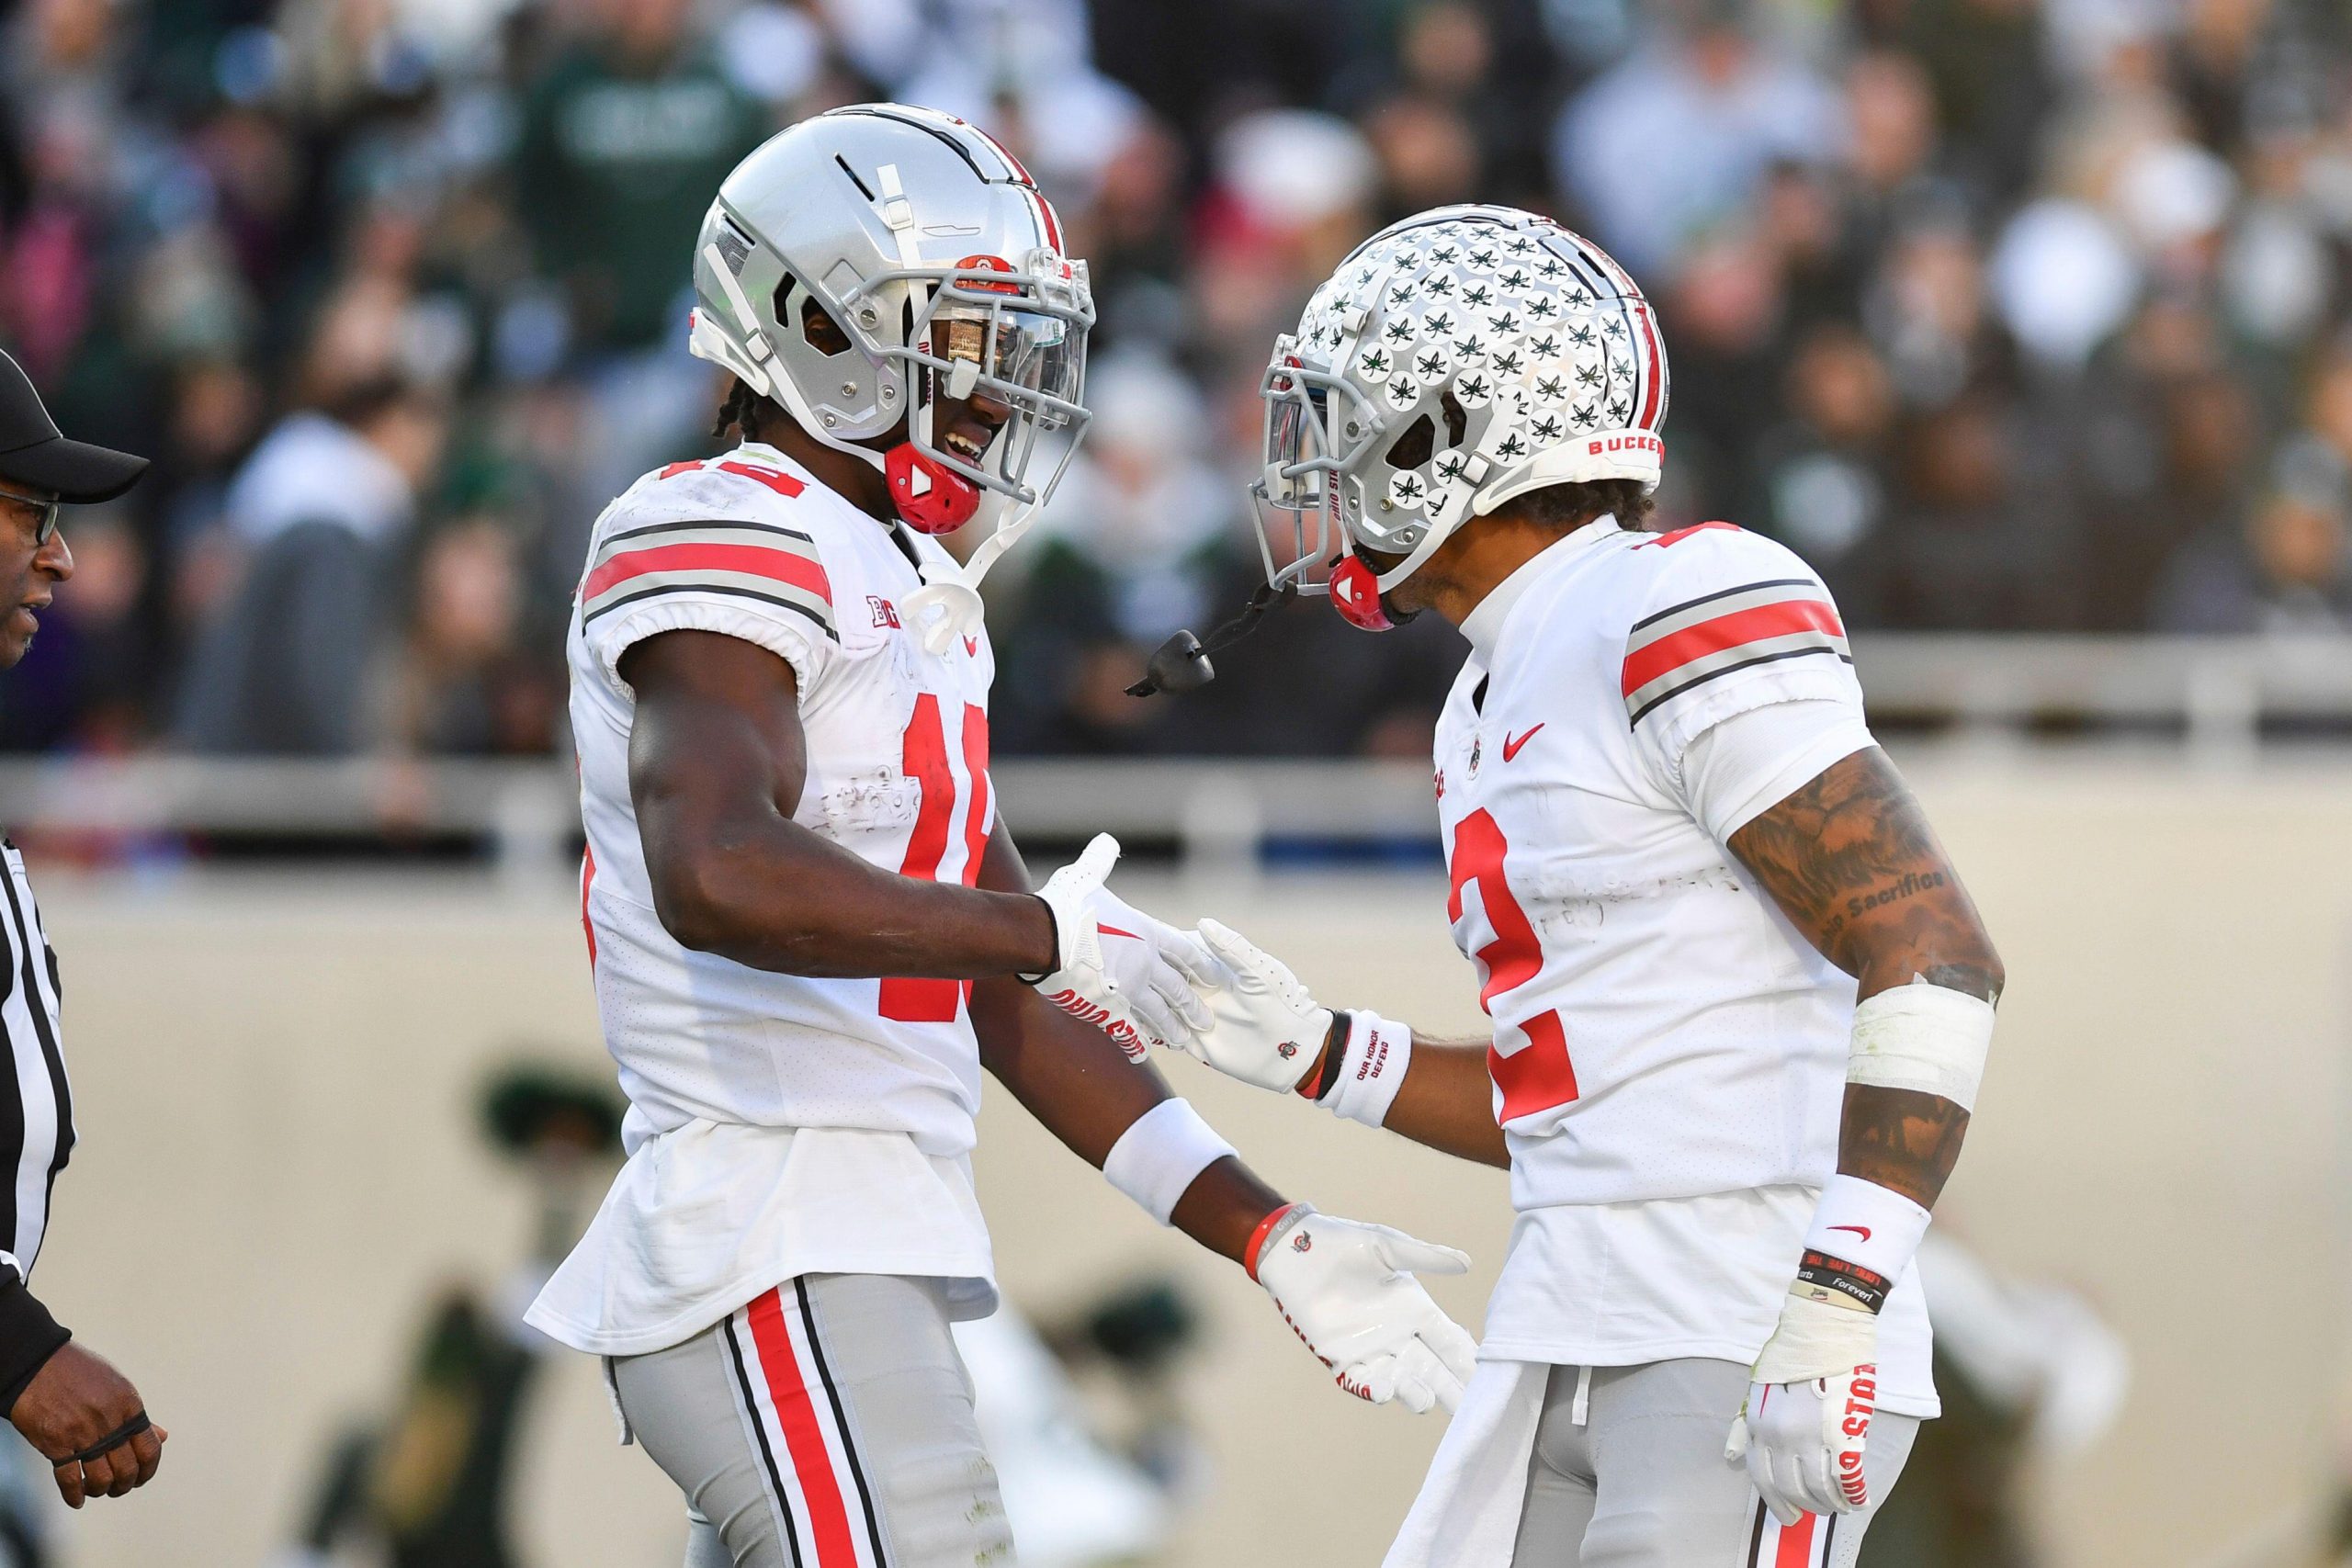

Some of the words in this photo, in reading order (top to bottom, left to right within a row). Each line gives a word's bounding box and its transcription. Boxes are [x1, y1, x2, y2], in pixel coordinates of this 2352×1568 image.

[1329, 468, 1339, 491] STA
[1847, 871, 1945, 918] Sacrifice
[1447, 807, 1579, 1123] 2
[1045, 987, 1110, 1026] OHIO
[1356, 1060, 1372, 1081] OUR
[1365, 1030, 1380, 1061] HONOR
[1370, 1041, 1389, 1078] DEFEND
[1832, 1277, 1874, 1303] Forever!
